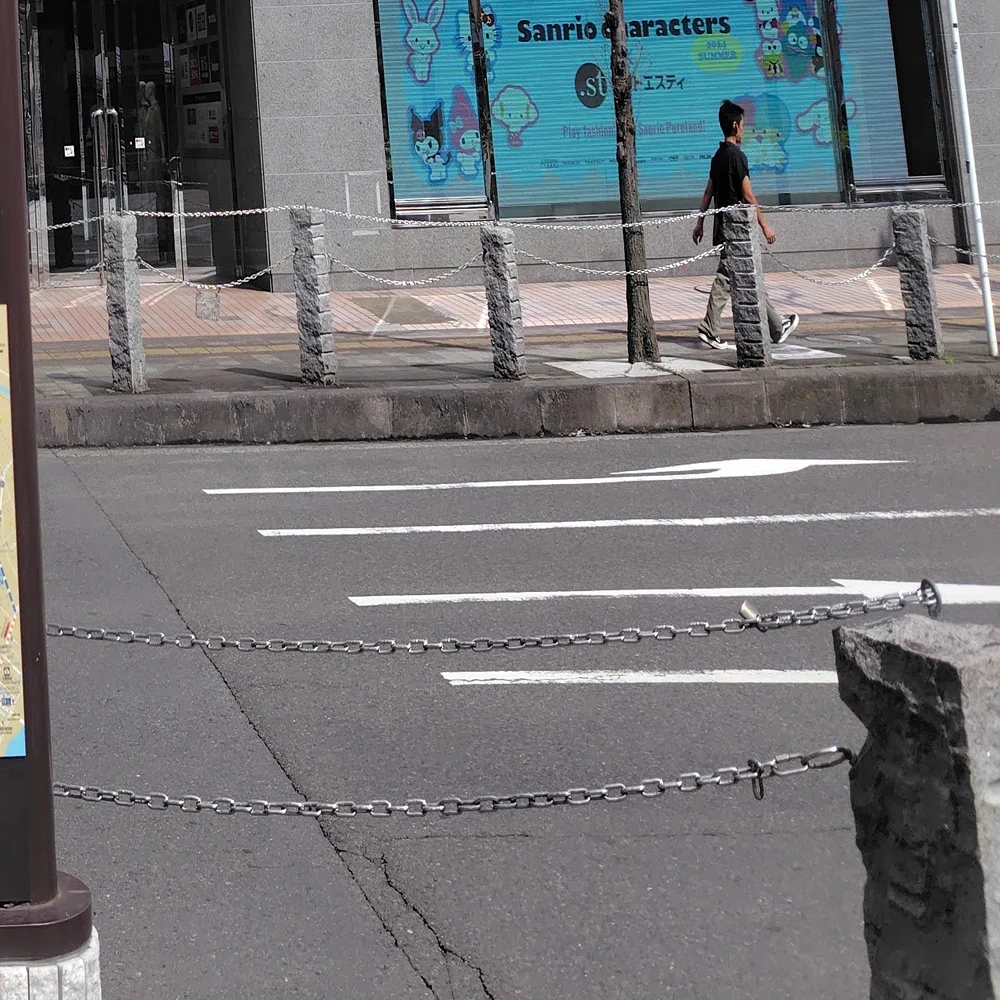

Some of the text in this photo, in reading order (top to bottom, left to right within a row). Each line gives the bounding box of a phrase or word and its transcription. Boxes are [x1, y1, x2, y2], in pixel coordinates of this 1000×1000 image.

[517, 15, 732, 43] Sanrio caracters
[697, 51, 738, 61] SUMMER
[562, 125, 583, 139] Play
